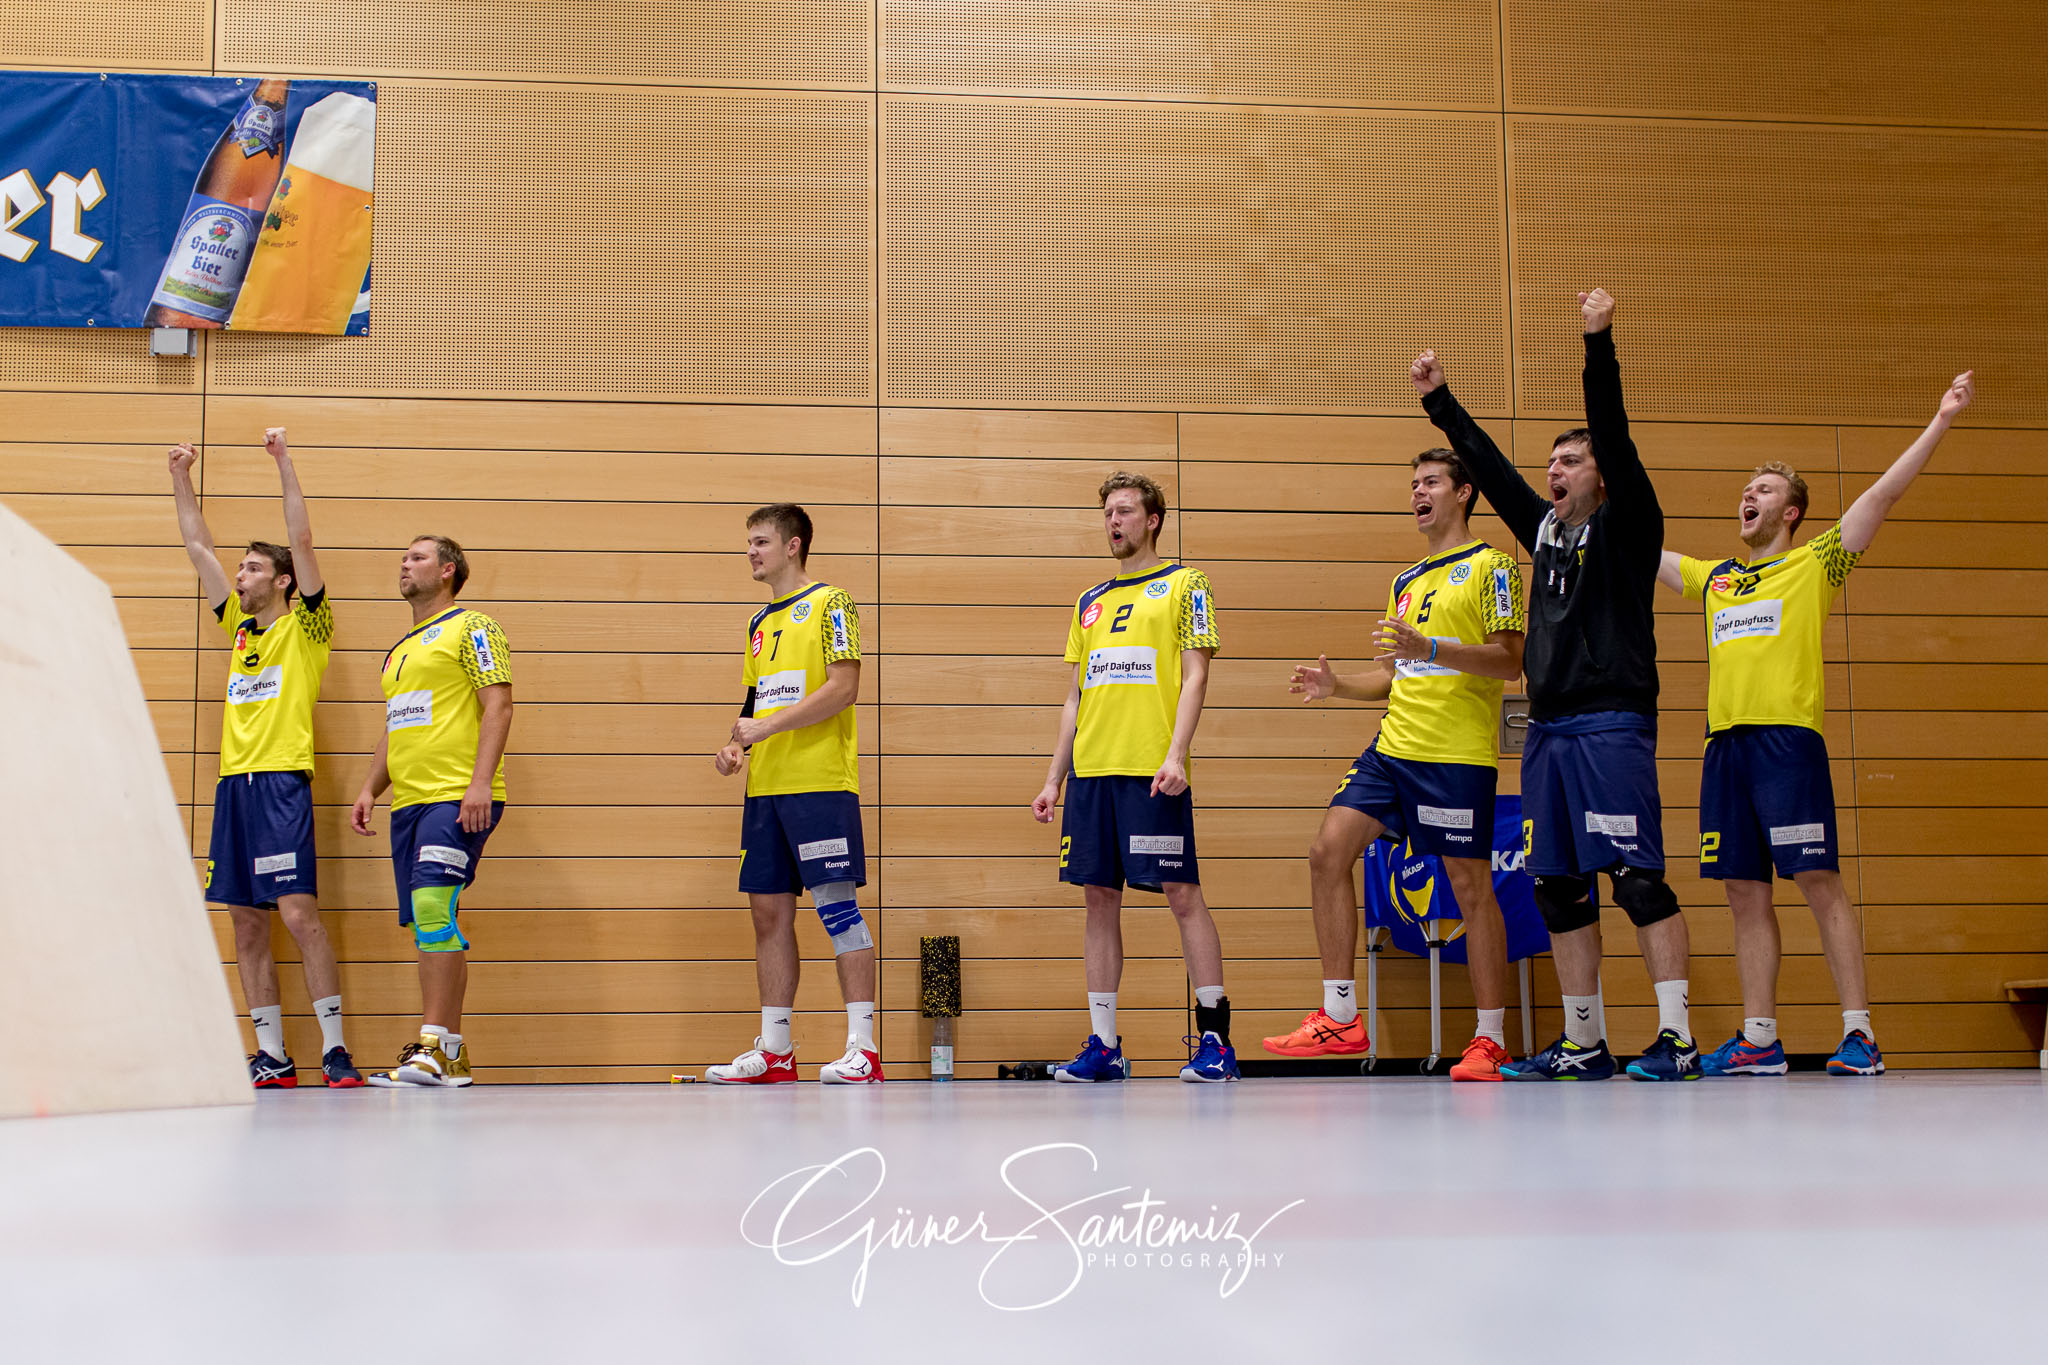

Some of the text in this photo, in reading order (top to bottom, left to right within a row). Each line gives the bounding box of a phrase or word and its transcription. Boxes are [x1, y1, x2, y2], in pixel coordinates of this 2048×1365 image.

[190, 235, 240, 261] Spalter
[192, 255, 222, 276] Bier
[1417, 589, 1438, 625] 5
[1110, 603, 1134, 634] 2
[1717, 620, 1733, 633] Zapf
[1734, 614, 1775, 628] Daigfuss
[770, 629, 784, 662] 7
[395, 653, 408, 682] 1
[1091, 661, 1152, 674] Zapf Daigfuss
[770, 684, 800, 697] Daigfuss
[392, 705, 425, 718] Daigfuss
[1445, 832, 1473, 844] Kempa
[1060, 835, 1072, 868] 2
[1802, 847, 1826, 856] Kempa
[825, 860, 850, 869] Kempa
[1158, 859, 1183, 869] Kempa
